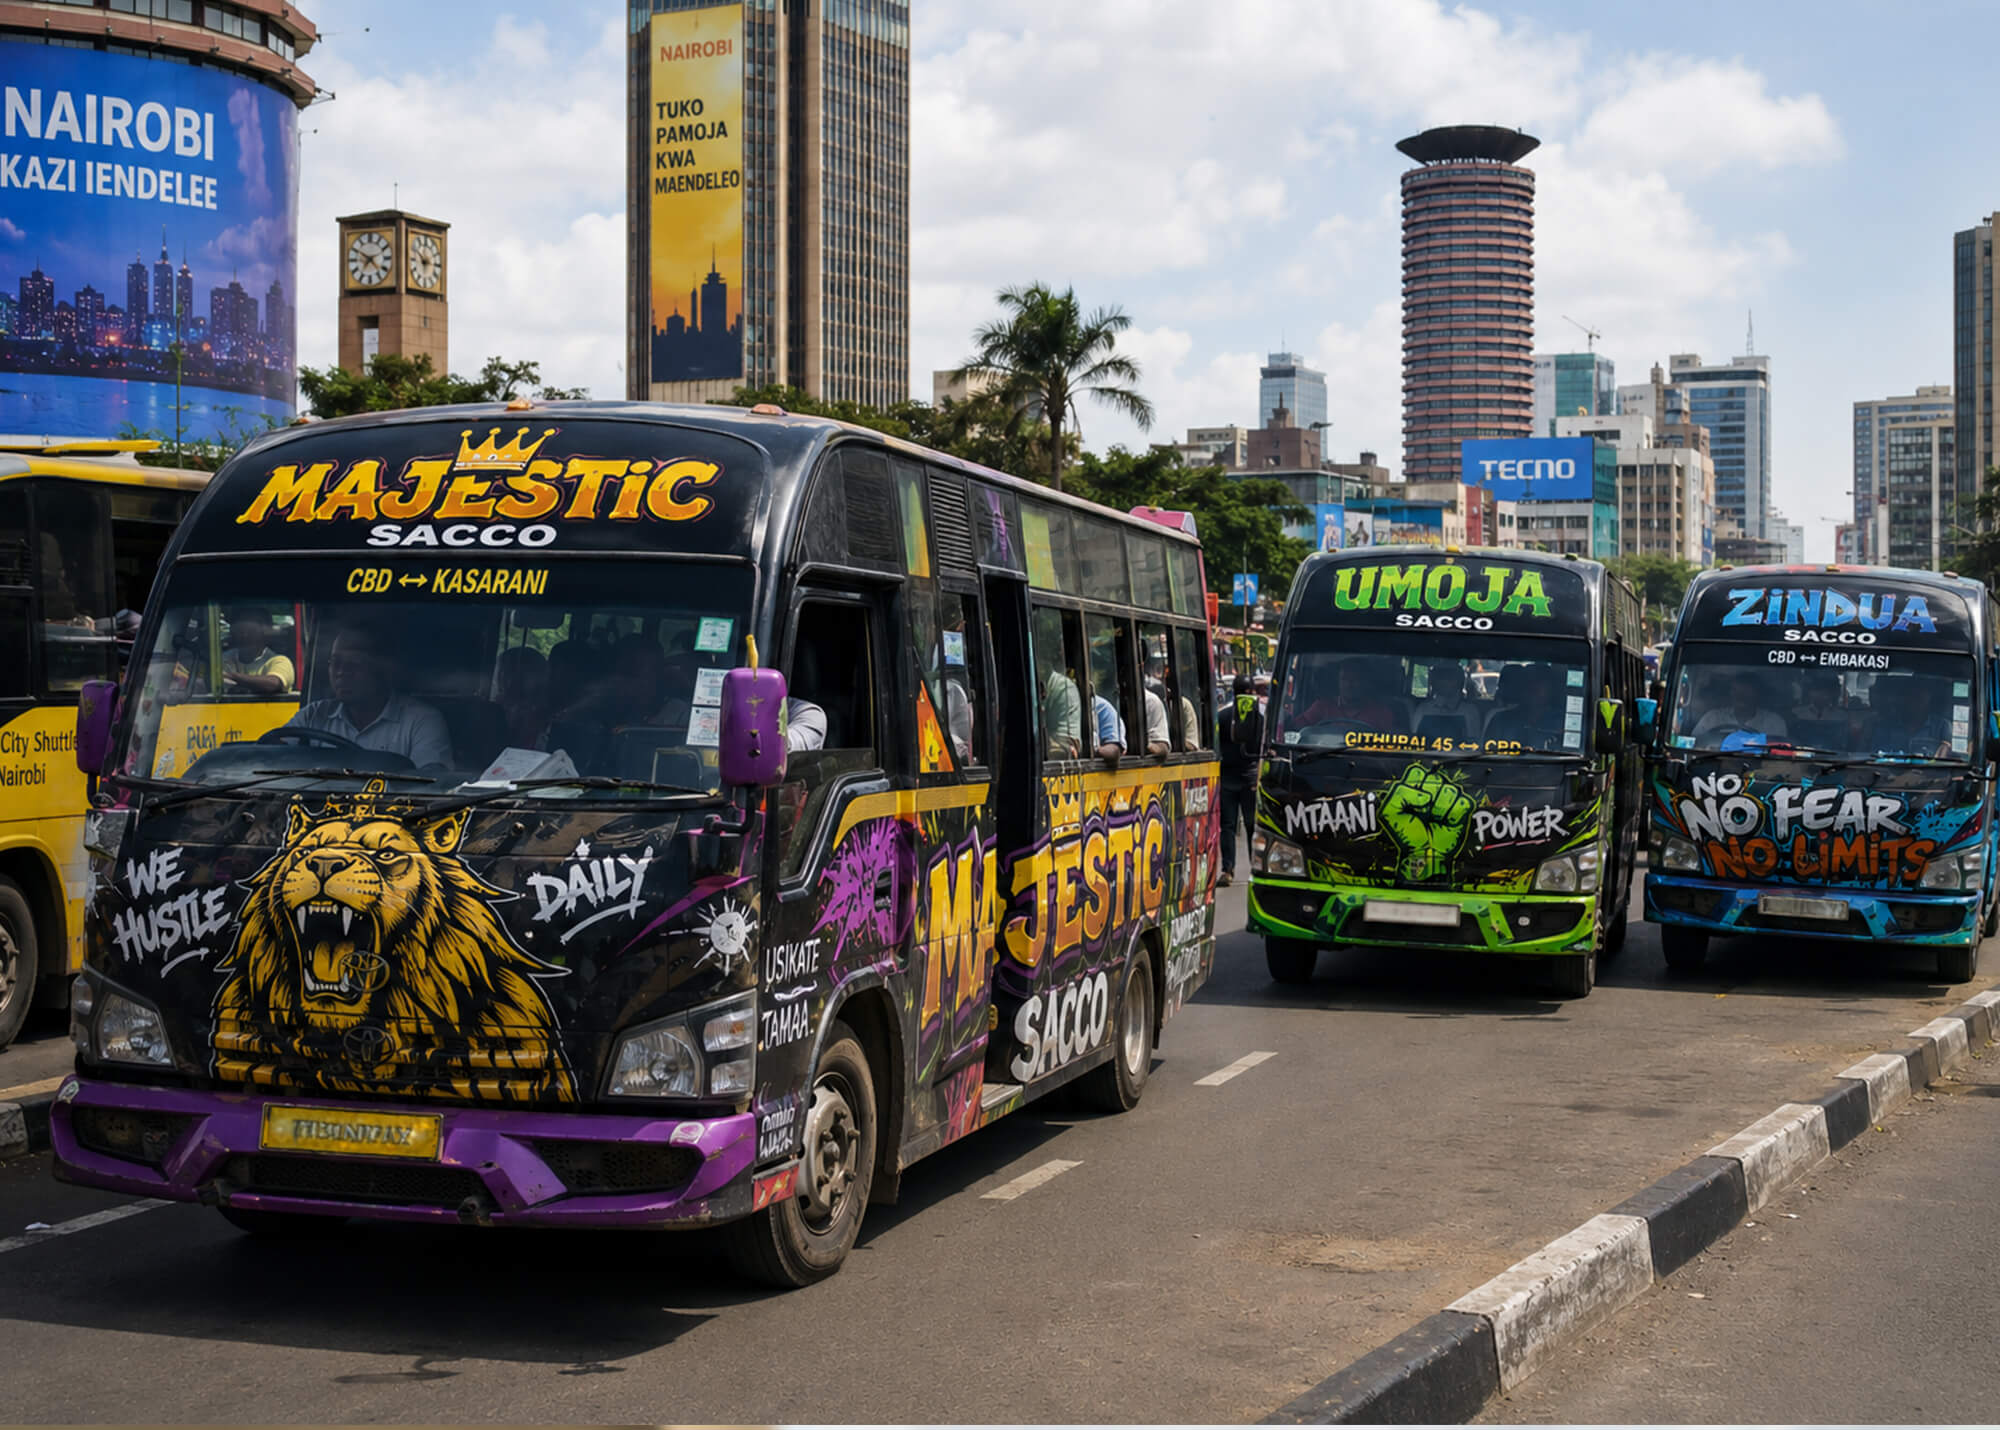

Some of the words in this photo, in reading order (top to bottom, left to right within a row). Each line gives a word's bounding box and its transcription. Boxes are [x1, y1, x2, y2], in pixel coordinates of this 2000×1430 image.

[660, 39, 733, 63] NAIROBI
[656, 98, 704, 120] TUKO
[5, 86, 214, 161] NAIROBI
[656, 120, 729, 145] PAMOJA
[656, 149, 696, 170] KWA
[0, 153, 76, 192] KAZI
[86, 160, 217, 210] IENDELEE
[655, 169, 740, 195] MAENDELEO
[1479, 458, 1576, 481] TECNO
[366, 523, 558, 547] SACCO
[347, 567, 393, 593] CBD
[432, 568, 548, 595] KASARANI
[1334, 564, 1553, 617] UMOJA
[1395, 613, 1494, 631] SACCO
[1784, 629, 1877, 645] SACCO
[1768, 650, 1796, 665] CBD
[1819, 652, 1889, 669] EMBAKASI
[1, 731, 29, 758] City
[1432, 736, 1453, 752] 45
[1485, 740, 1521, 756] CBD
[1692, 772, 1743, 800] NO
[1473, 806, 1569, 841] POWER
[1680, 795, 1759, 841] NO
[1774, 787, 1909, 839] FEAR
[1708, 836, 1778, 877] NO
[127, 847, 186, 899] WE
[526, 845, 653, 922] DAILY
[113, 884, 231, 965] HUSTLE
[765, 938, 820, 985] USIKATE
[1011, 971, 1109, 1083] SACCO
